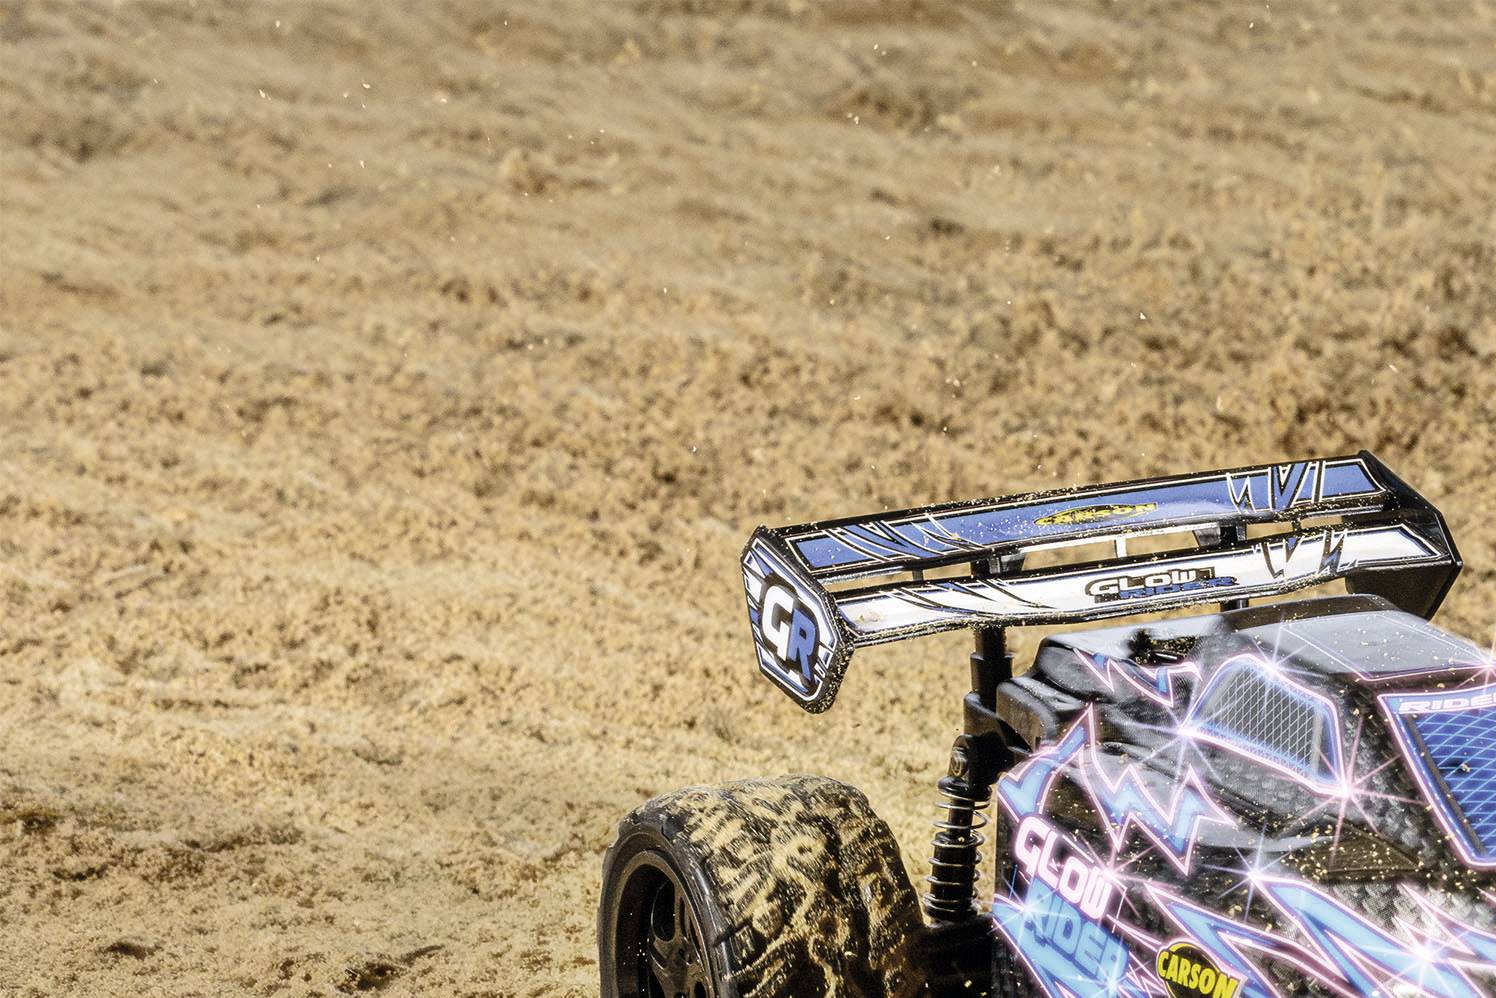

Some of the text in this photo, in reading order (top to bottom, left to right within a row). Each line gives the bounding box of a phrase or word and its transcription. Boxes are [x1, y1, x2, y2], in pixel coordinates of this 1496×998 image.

[1089, 568, 1197, 595] GLOW
[1015, 815, 1114, 920] GLOW
[1021, 877, 1129, 985] RIDER
